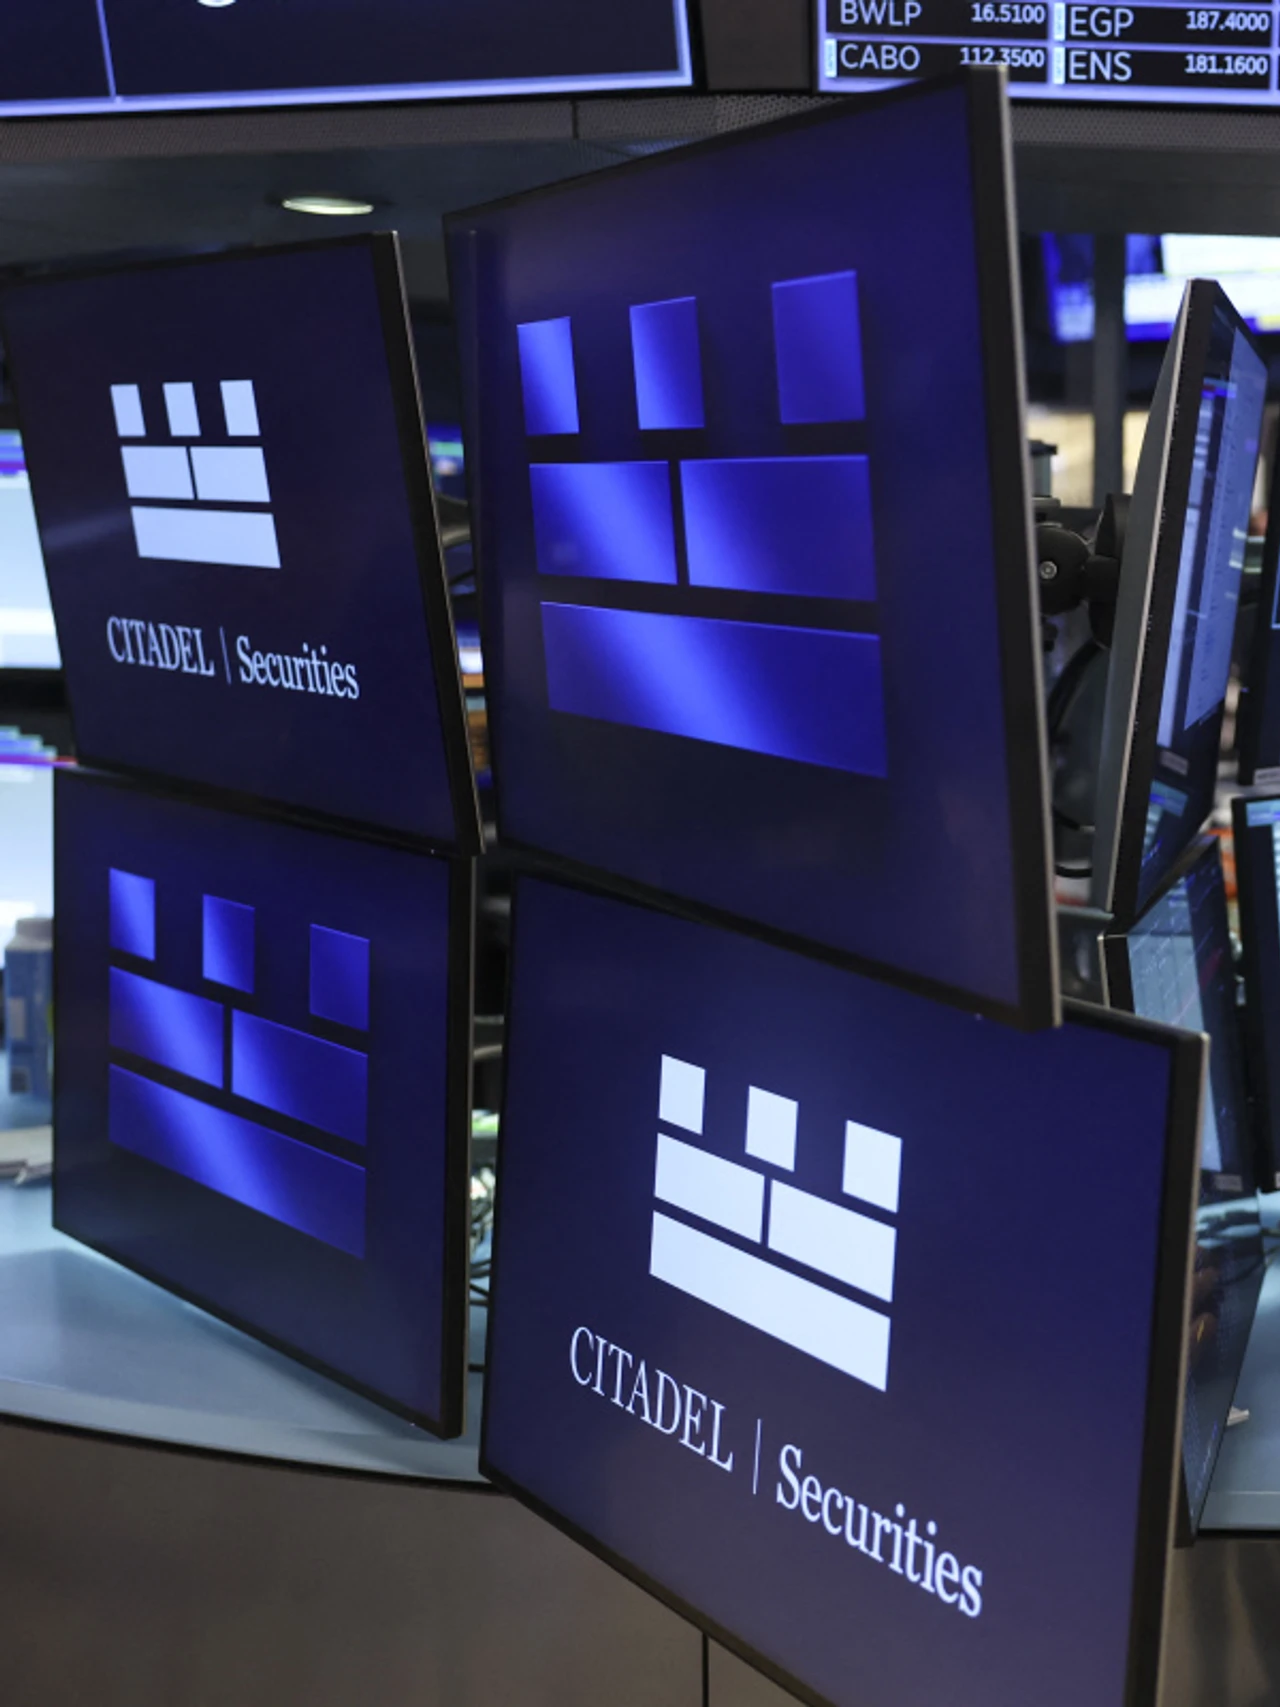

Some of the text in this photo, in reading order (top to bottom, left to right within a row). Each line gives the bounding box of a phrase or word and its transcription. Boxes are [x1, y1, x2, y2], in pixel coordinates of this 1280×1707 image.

[840, 0, 1045, 27] BWLP 16.5100
[1069, 6, 1269, 37] EGP 187.4000
[840, 43, 1045, 71] CABO 112.3500
[1069, 50, 1268, 81] ENS 181.1600
[107, 616, 360, 699] CITADEL Securities
[569, 1326, 983, 1618] CITADEL Securities
